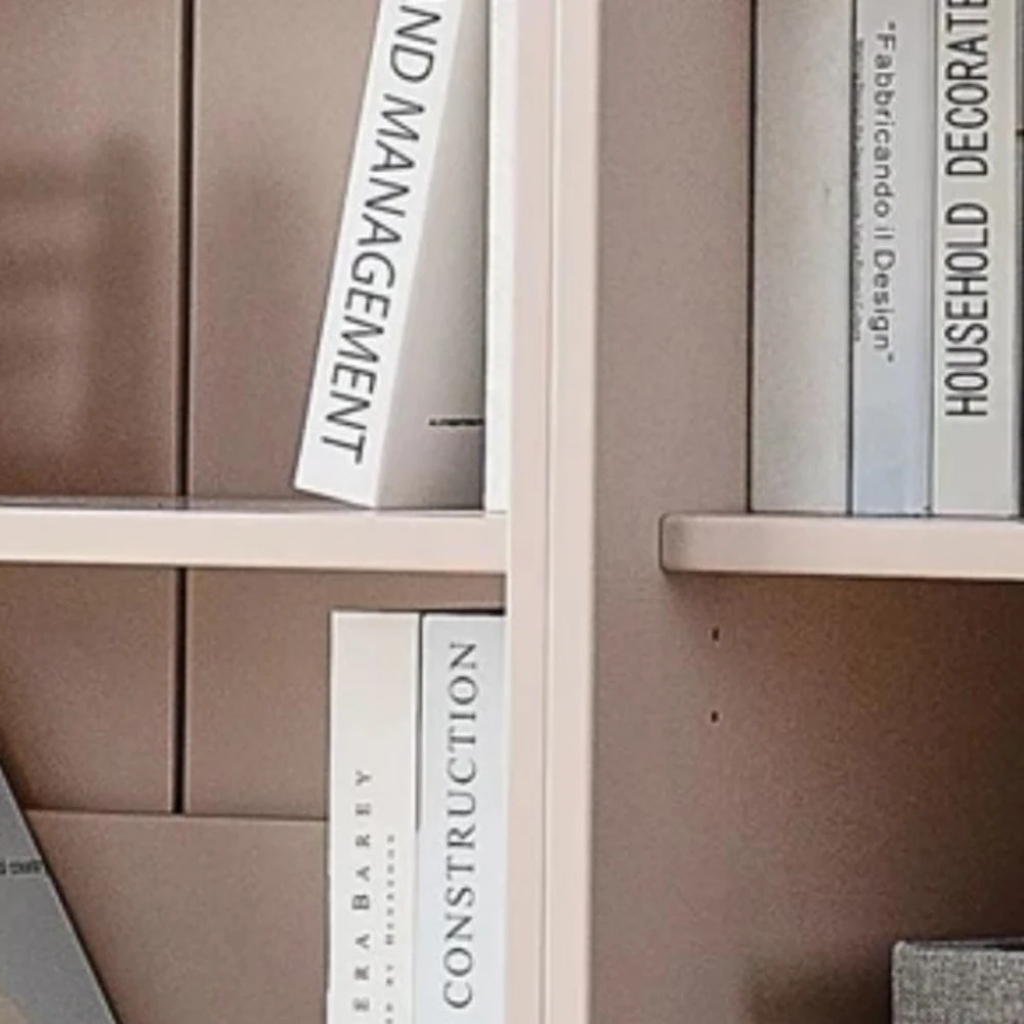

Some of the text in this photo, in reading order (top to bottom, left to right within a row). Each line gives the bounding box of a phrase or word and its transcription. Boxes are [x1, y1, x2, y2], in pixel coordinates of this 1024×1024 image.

[321, 93, 426, 464] MANAGEMENT
[867, 249, 896, 363] Design"
[874, 227, 895, 240] il
[944, 202, 989, 416] HOUSEHOLD
[442, 640, 479, 1010] CONSTRUCTION
